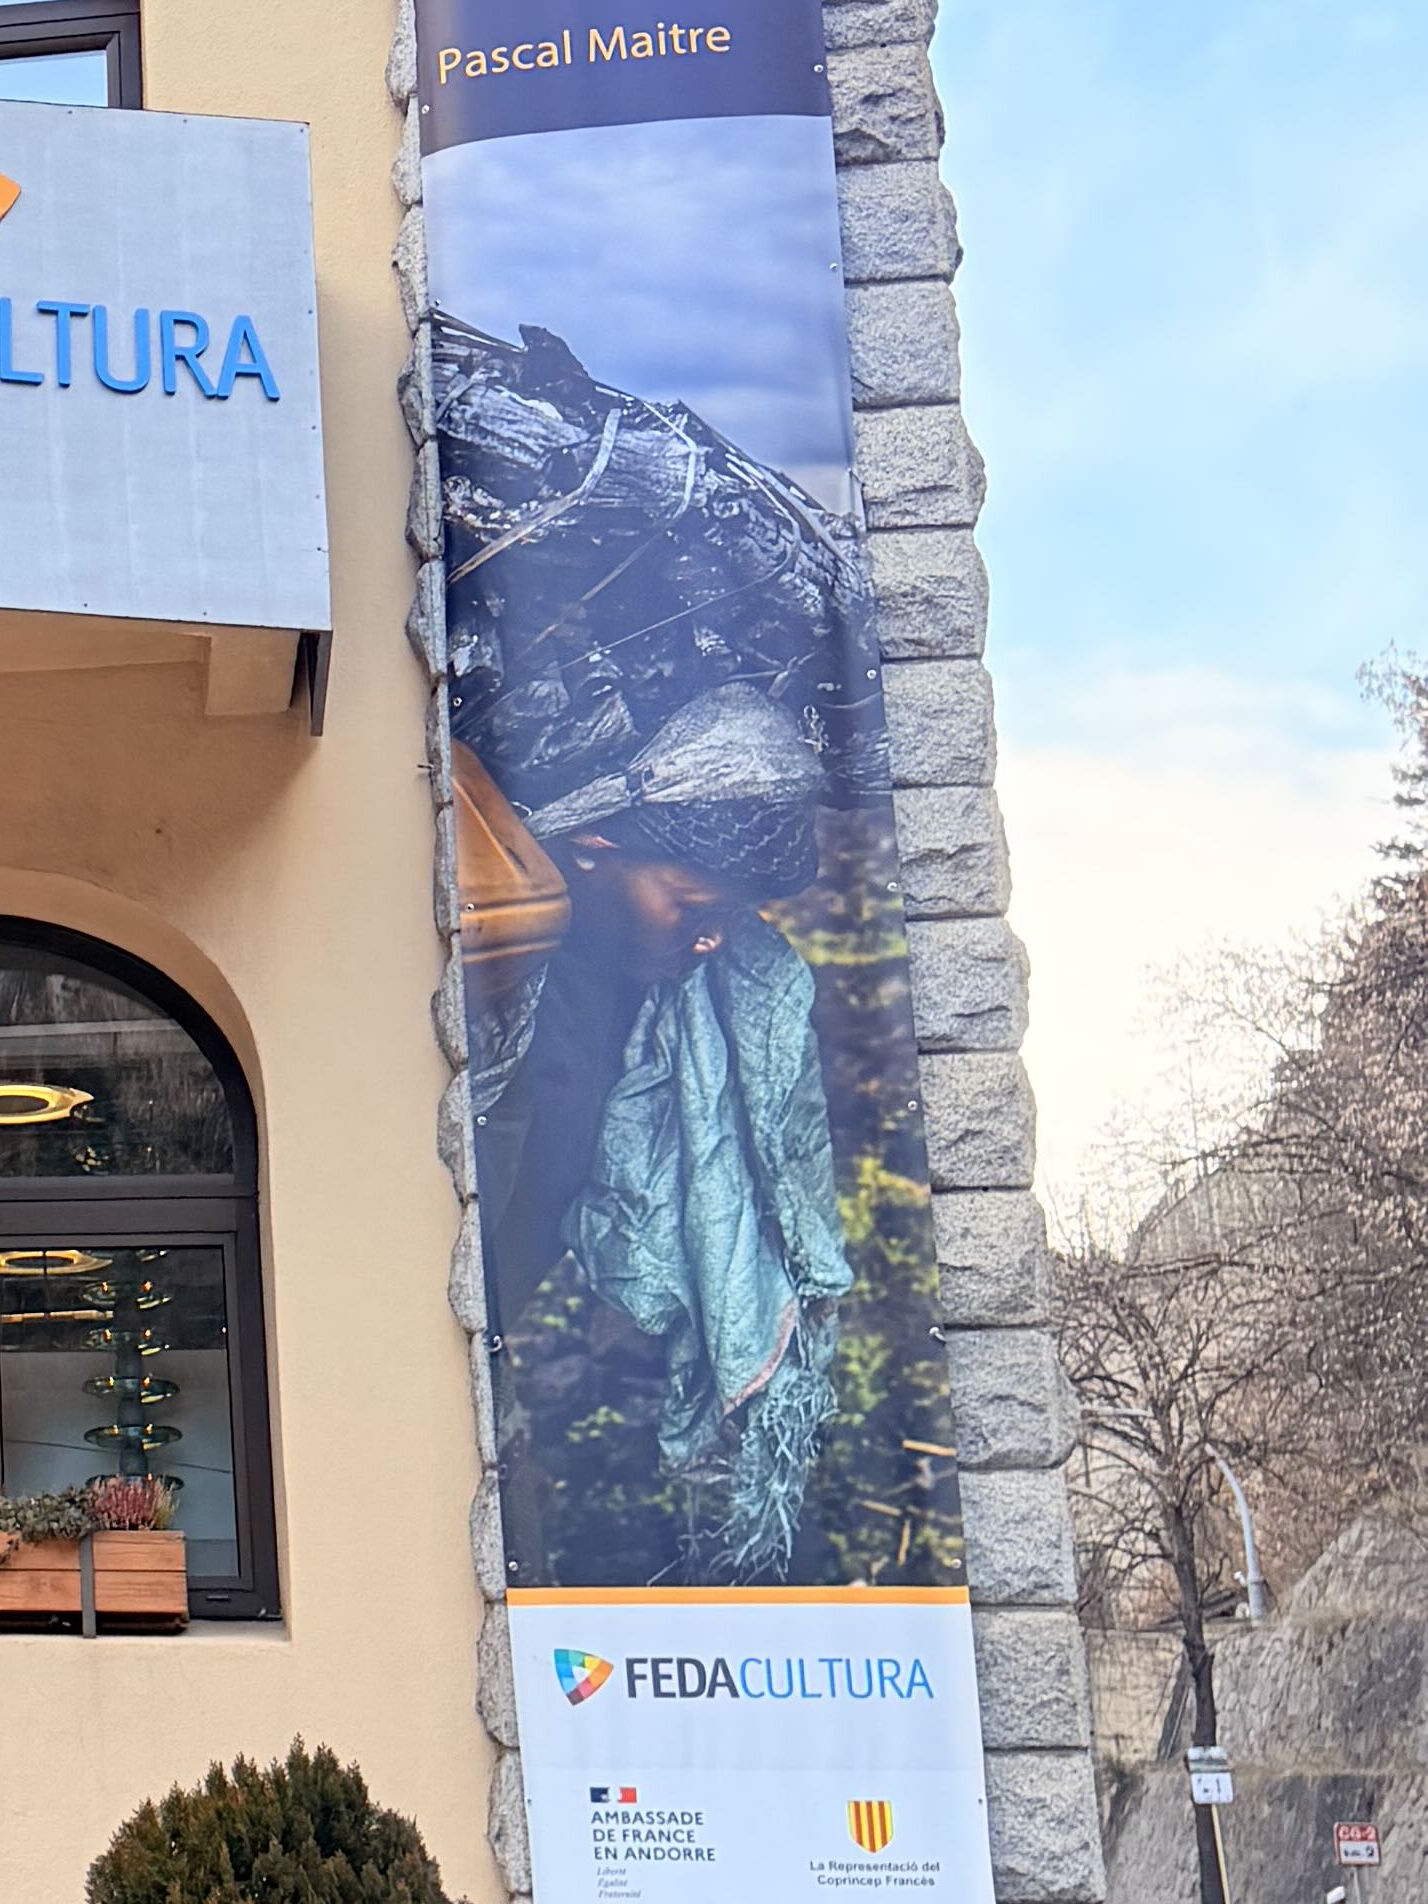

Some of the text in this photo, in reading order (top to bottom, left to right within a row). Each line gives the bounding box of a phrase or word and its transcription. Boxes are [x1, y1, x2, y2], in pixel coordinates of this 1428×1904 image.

[438, 20, 732, 84] Pascal Maitre
[625, 1657, 934, 1700] FEDACULTURA
[591, 1811, 704, 1826] AMBASSADE
[593, 1828, 696, 1843] DE FRANCE
[594, 1846, 716, 1862] EN ANDORRE
[810, 1860, 825, 1872] La
[922, 1861, 940, 1872] del
